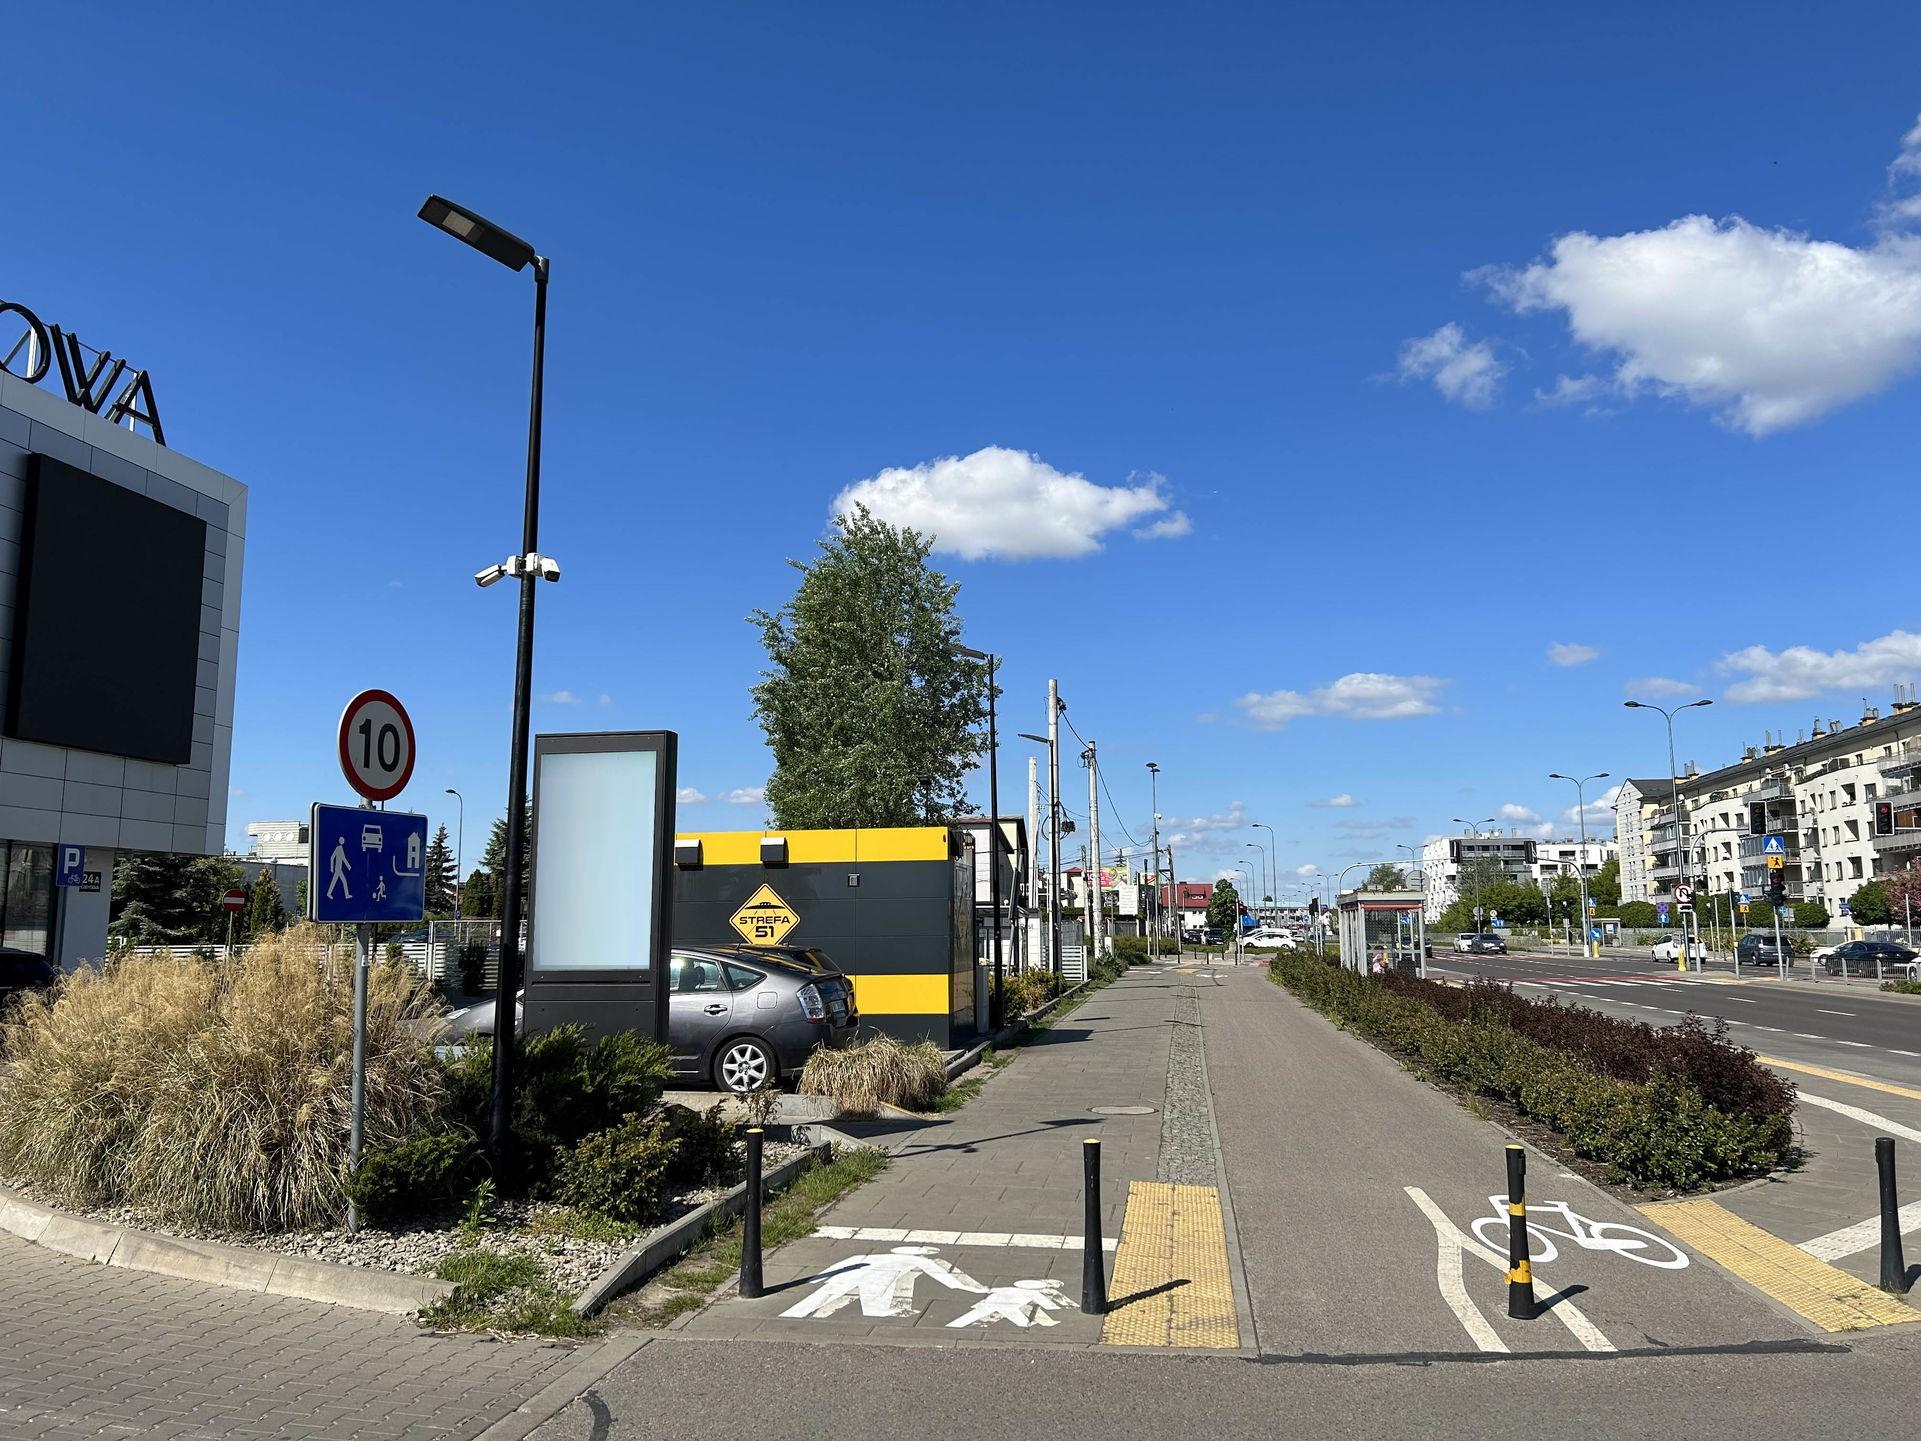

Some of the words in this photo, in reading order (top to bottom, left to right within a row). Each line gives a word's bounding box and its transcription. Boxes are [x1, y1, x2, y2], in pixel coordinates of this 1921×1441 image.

[359, 718, 401, 773] 10
[63, 847, 80, 874] P
[82, 873, 100, 885] 24A
[739, 916, 791, 925] STREFA
[755, 925, 775, 938] 51
